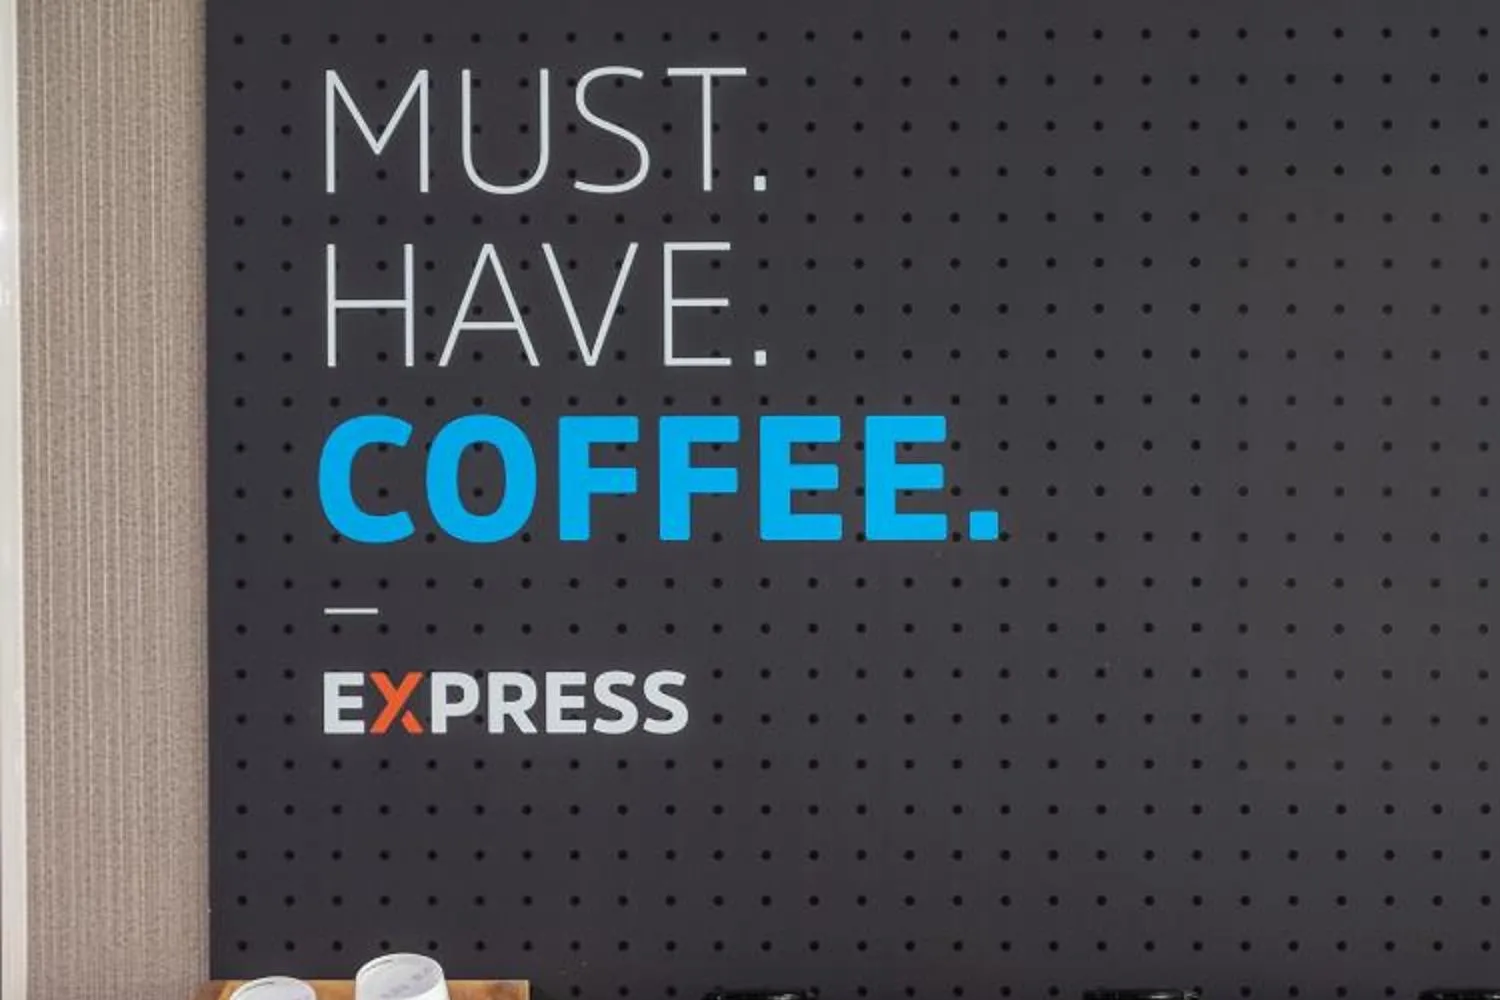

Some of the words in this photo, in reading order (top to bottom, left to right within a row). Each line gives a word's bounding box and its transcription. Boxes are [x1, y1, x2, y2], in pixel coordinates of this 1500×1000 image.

[325, 66, 767, 195] MUST.
[326, 242, 767, 368] HAVE.
[318, 414, 1000, 544] COFFEE.
[323, 671, 689, 735] EXPRESS
